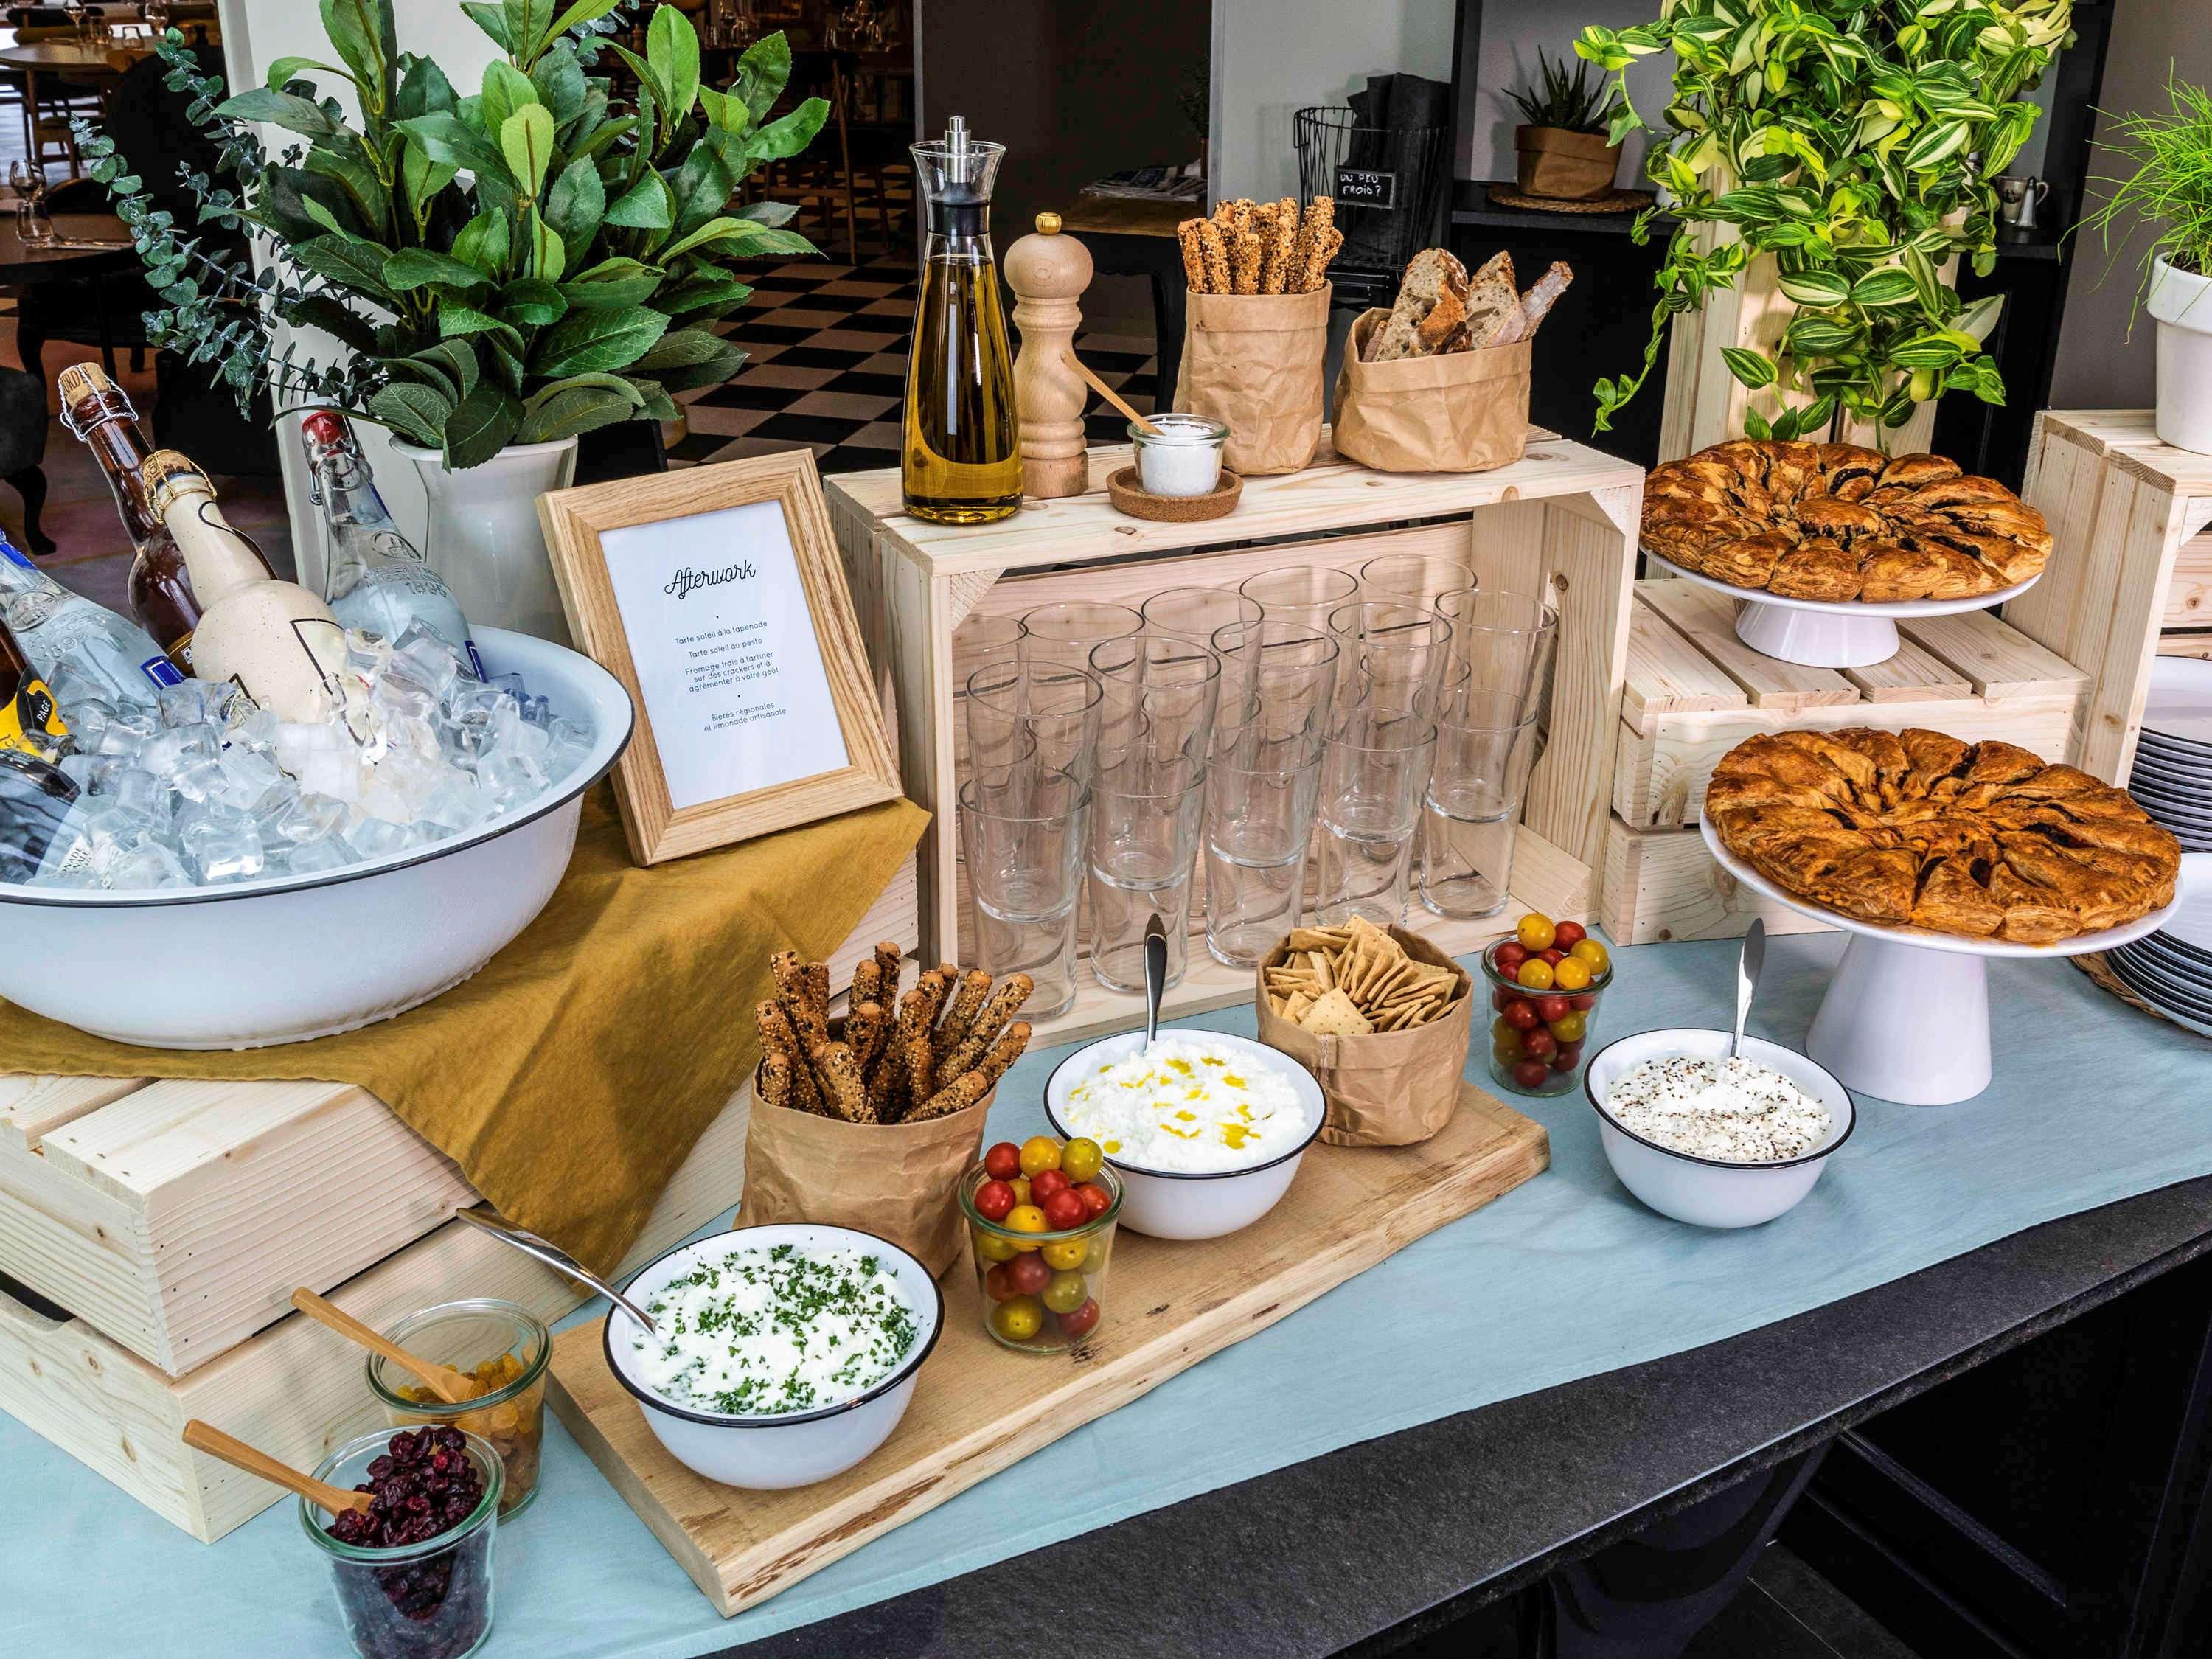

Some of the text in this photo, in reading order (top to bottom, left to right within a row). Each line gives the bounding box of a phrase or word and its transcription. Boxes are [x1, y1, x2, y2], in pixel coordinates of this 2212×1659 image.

[1359, 173, 1379, 184] PEU
[664, 560, 757, 600] Afterwork
[675, 636, 695, 646] Tarte
[696, 631, 716, 641] soleil
[723, 627, 731, 636] la
[732, 620, 768, 633] tapenade
[688, 638, 763, 658] Tarte soleil au pesto
[684, 664, 720, 675] Fromage
[721, 658, 738, 667] frais
[746, 651, 773, 663] tartiner
[694, 675, 706, 683] sur
[708, 671, 722, 680] des
[723, 664, 755, 677] crackers
[689, 677, 733, 693] agrémenter
[742, 672, 760, 681] votre
[762, 666, 779, 678] goût
[36, 699, 51, 723] PAGE
[704, 708, 787, 732] et limonade artisanale
[711, 702, 775, 722] Bières régionales
